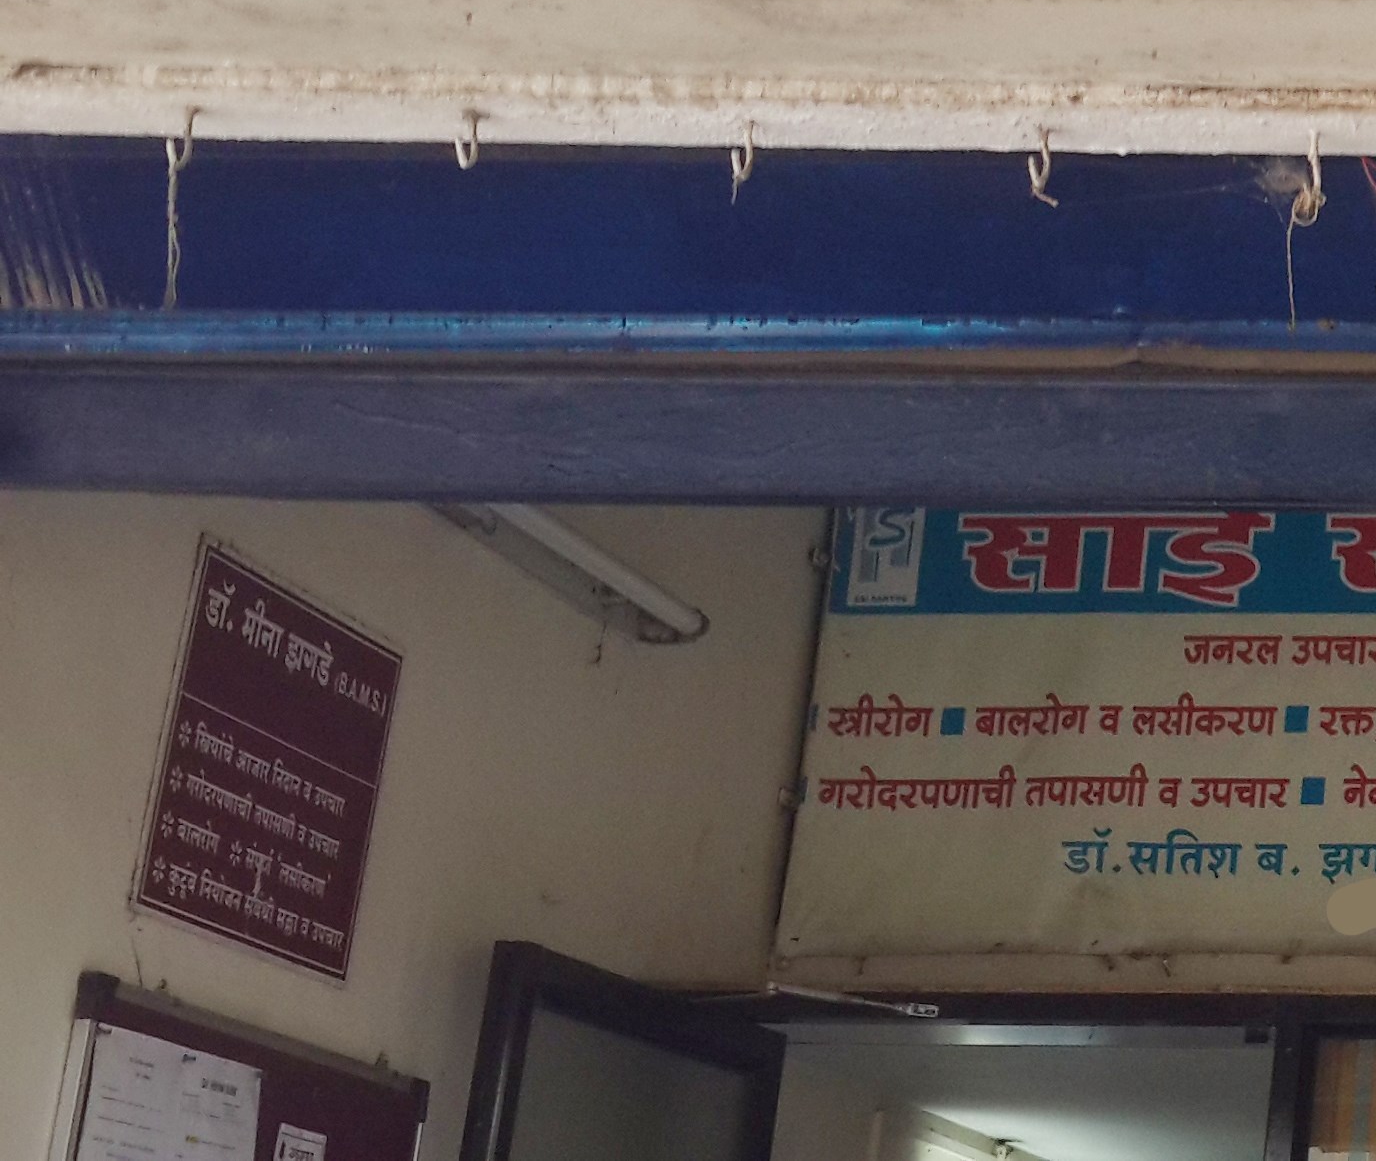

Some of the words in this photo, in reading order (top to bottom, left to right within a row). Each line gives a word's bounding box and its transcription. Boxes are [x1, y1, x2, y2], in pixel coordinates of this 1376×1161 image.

[242, 598, 285, 658] मीना
[1184, 634, 1282, 665] जनरल
[827, 693, 934, 737] स्त्रीरोग
[975, 692, 1090, 736] बालरोग
[1100, 705, 1123, 736] व
[1133, 692, 1278, 737] लसीकरण
[818, 765, 1016, 809] गरोदरपणाची
[1026, 763, 1149, 808] तपासणी
[1159, 777, 1182, 808] व
[1191, 777, 1290, 809] उपचार
[1256, 843, 1300, 876] ब.
